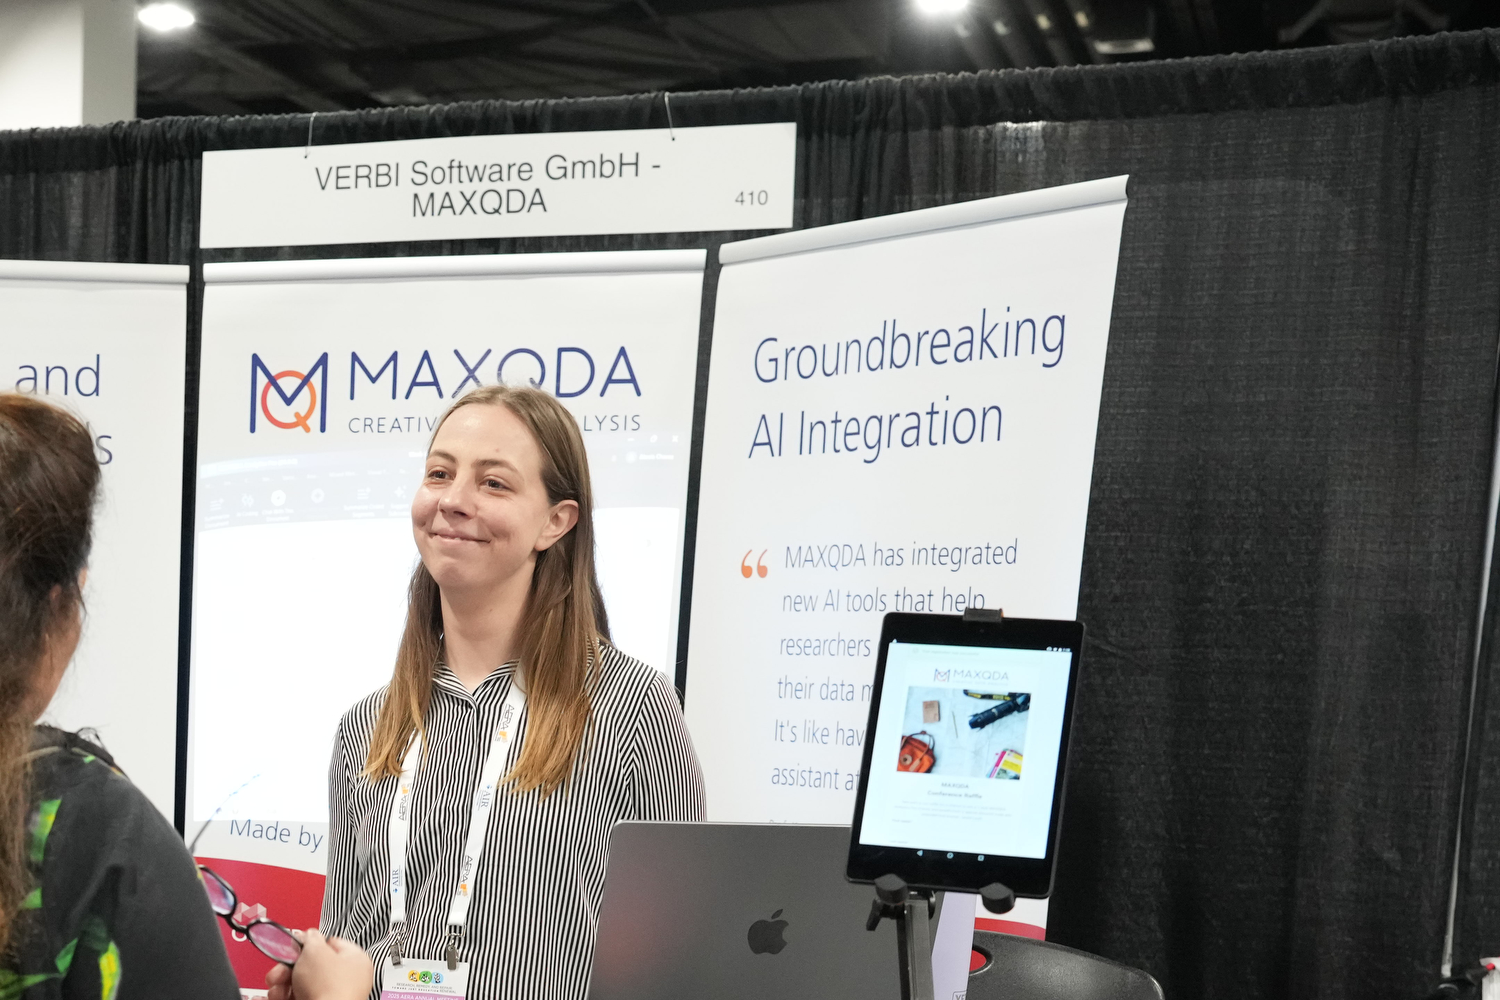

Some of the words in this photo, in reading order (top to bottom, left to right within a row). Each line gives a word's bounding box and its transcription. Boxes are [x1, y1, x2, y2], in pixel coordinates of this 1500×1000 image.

[316, 162, 400, 190] VERBI
[410, 158, 534, 187] Software
[544, 152, 640, 180] GmbH
[412, 188, 548, 217] MAXQDA
[734, 190, 769, 207] 410
[753, 306, 1067, 384] Groundbreaking
[14, 354, 101, 397] and
[349, 346, 642, 400] MAXQDA
[348, 415, 436, 434] CREATIV
[583, 414, 641, 432] LYSIS
[748, 411, 784, 459] AI
[798, 395, 1003, 464] Integration
[785, 543, 867, 572] MAXQDA
[872, 541, 905, 568] has
[911, 538, 1019, 573] integrated
[781, 592, 818, 614] new
[822, 588, 842, 614] AI
[845, 588, 888, 613] tools
[893, 587, 934, 613] that
[941, 586, 985, 611] help
[779, 631, 872, 658] researchers
[777, 674, 815, 701] their
[819, 675, 855, 701] data
[953, 669, 1009, 681] MAXQDA
[774, 718, 798, 744] It's
[802, 718, 830, 746] like
[835, 721, 865, 747] hav
[771, 764, 840, 791] assistant
[229, 819, 291, 843] Made
[298, 824, 323, 853] by
